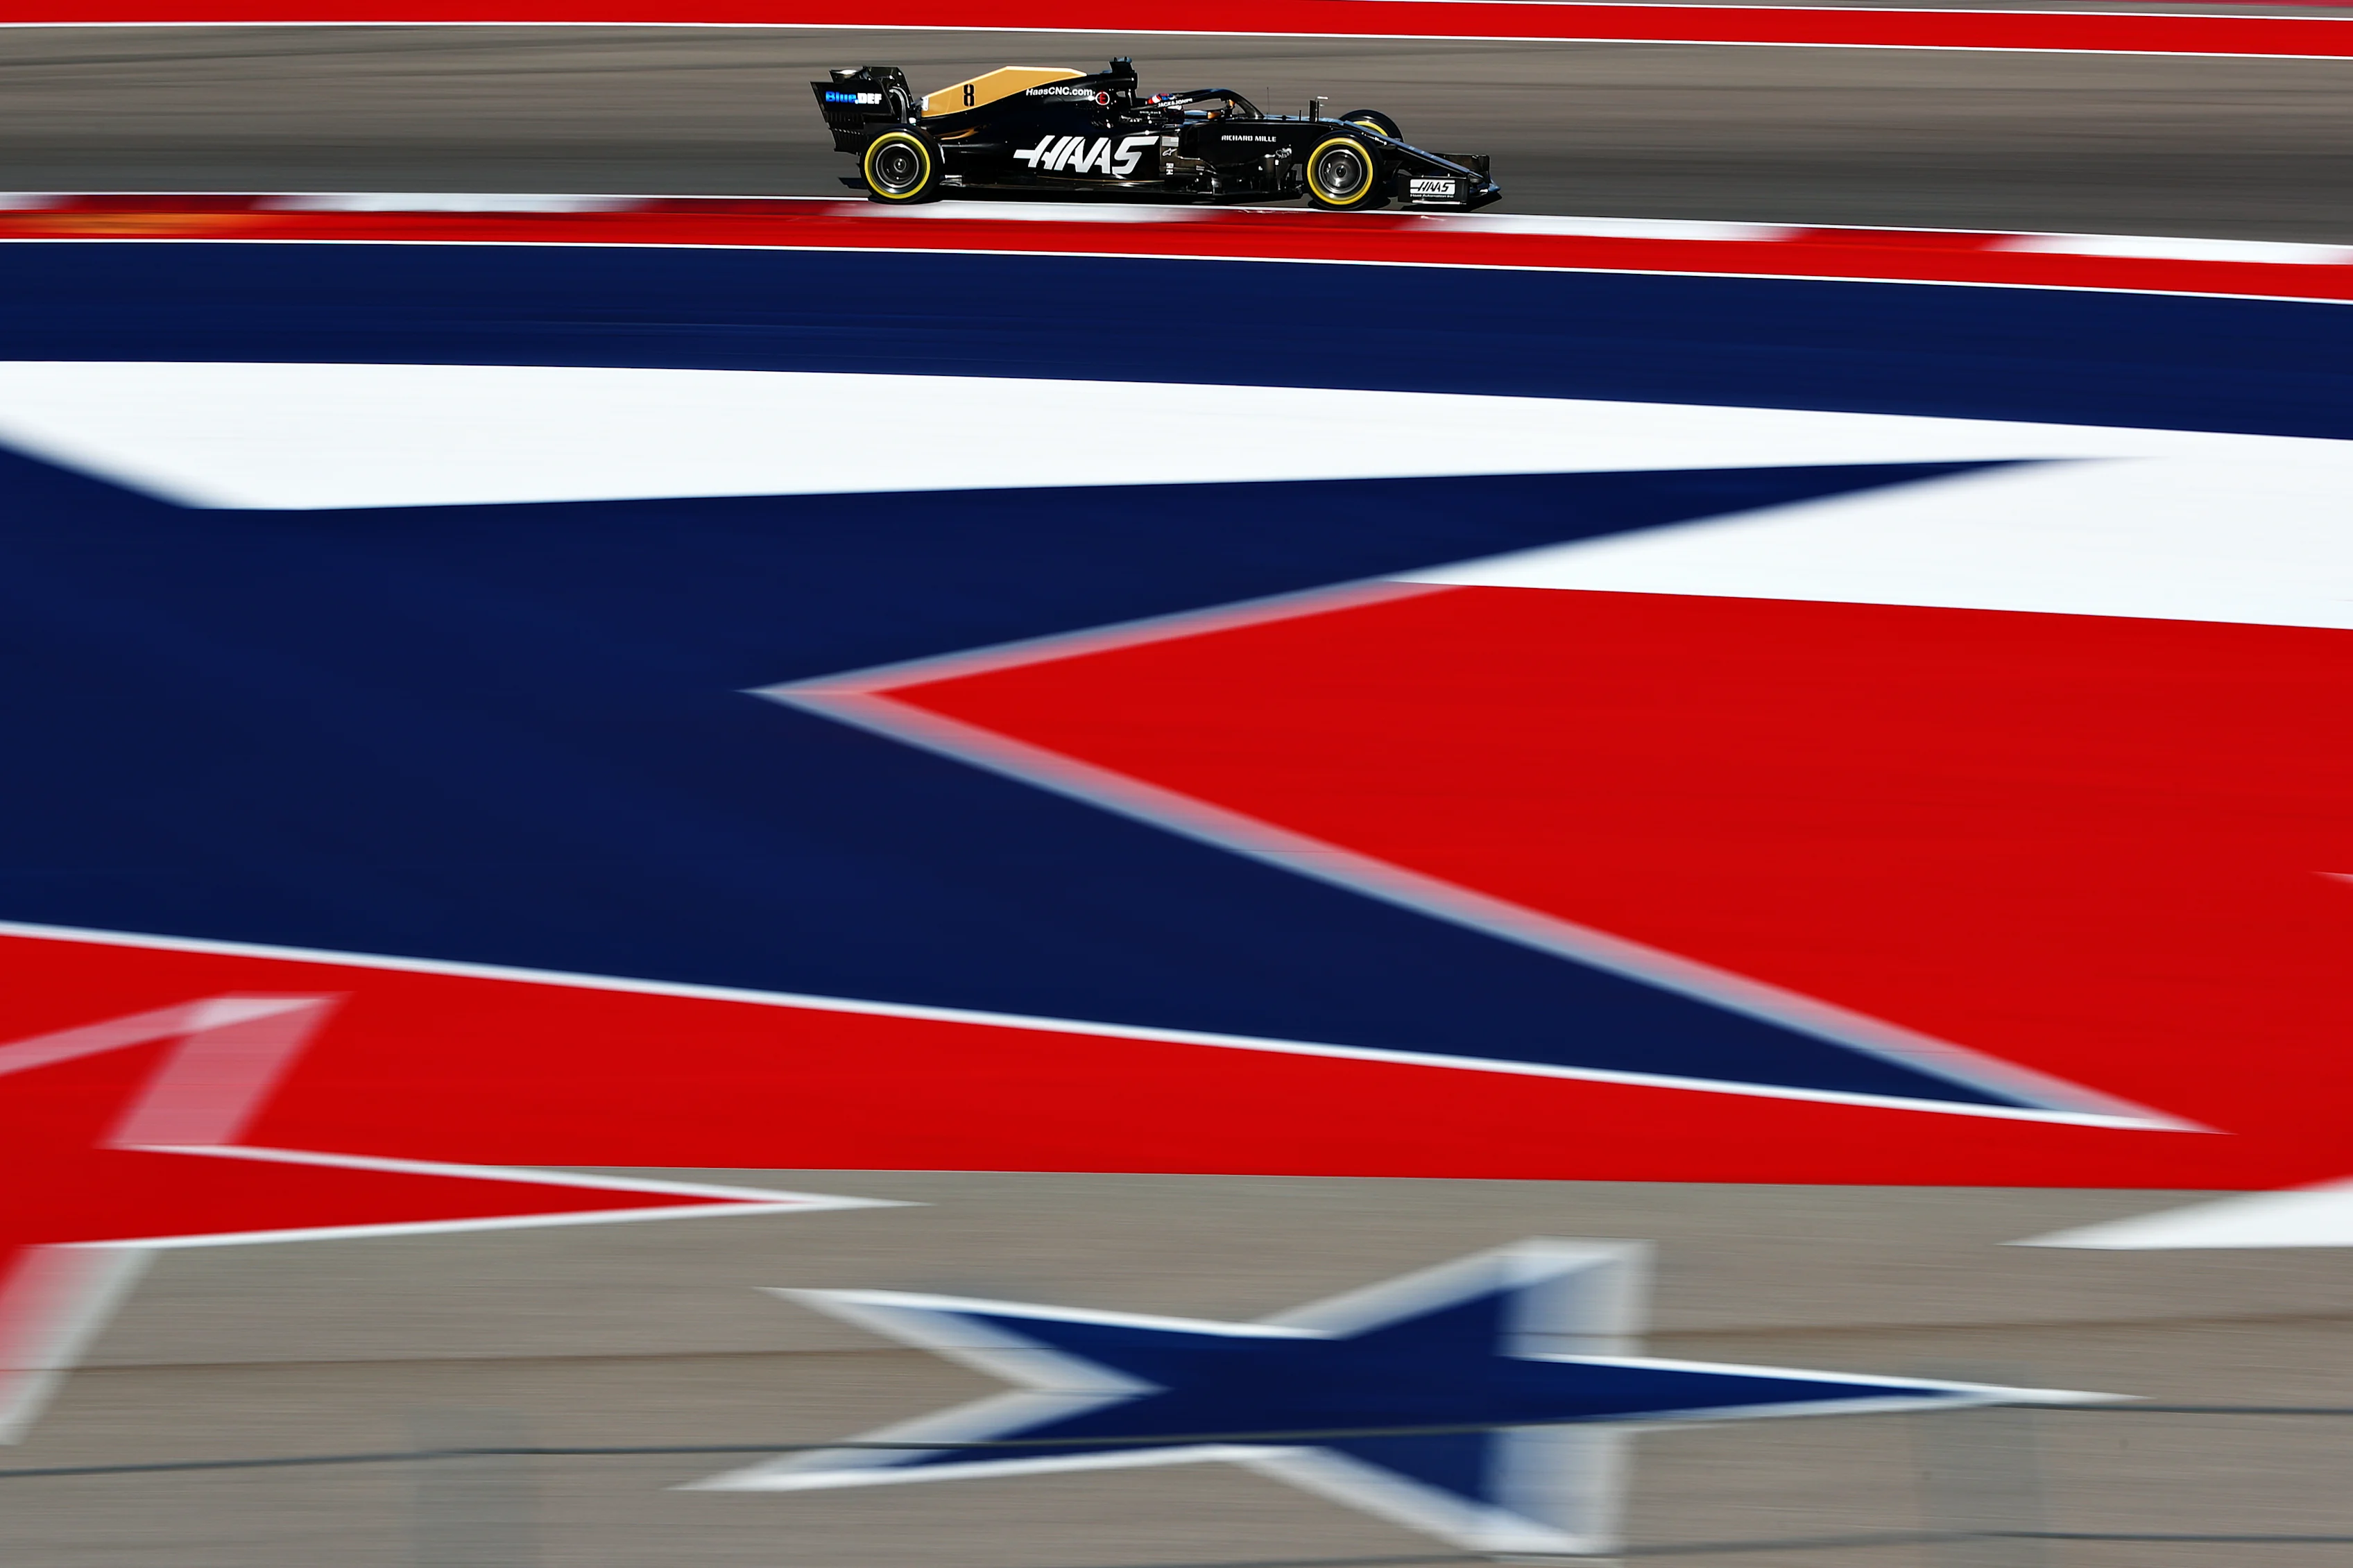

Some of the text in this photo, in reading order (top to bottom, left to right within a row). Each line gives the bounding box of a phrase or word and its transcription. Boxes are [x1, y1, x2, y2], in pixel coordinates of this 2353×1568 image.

[964, 84, 975, 107] 8
[1026, 87, 1093, 96] HaasCNC.com
[1013, 135, 1159, 175] HAAS
[1410, 181, 1455, 192] HAAS
